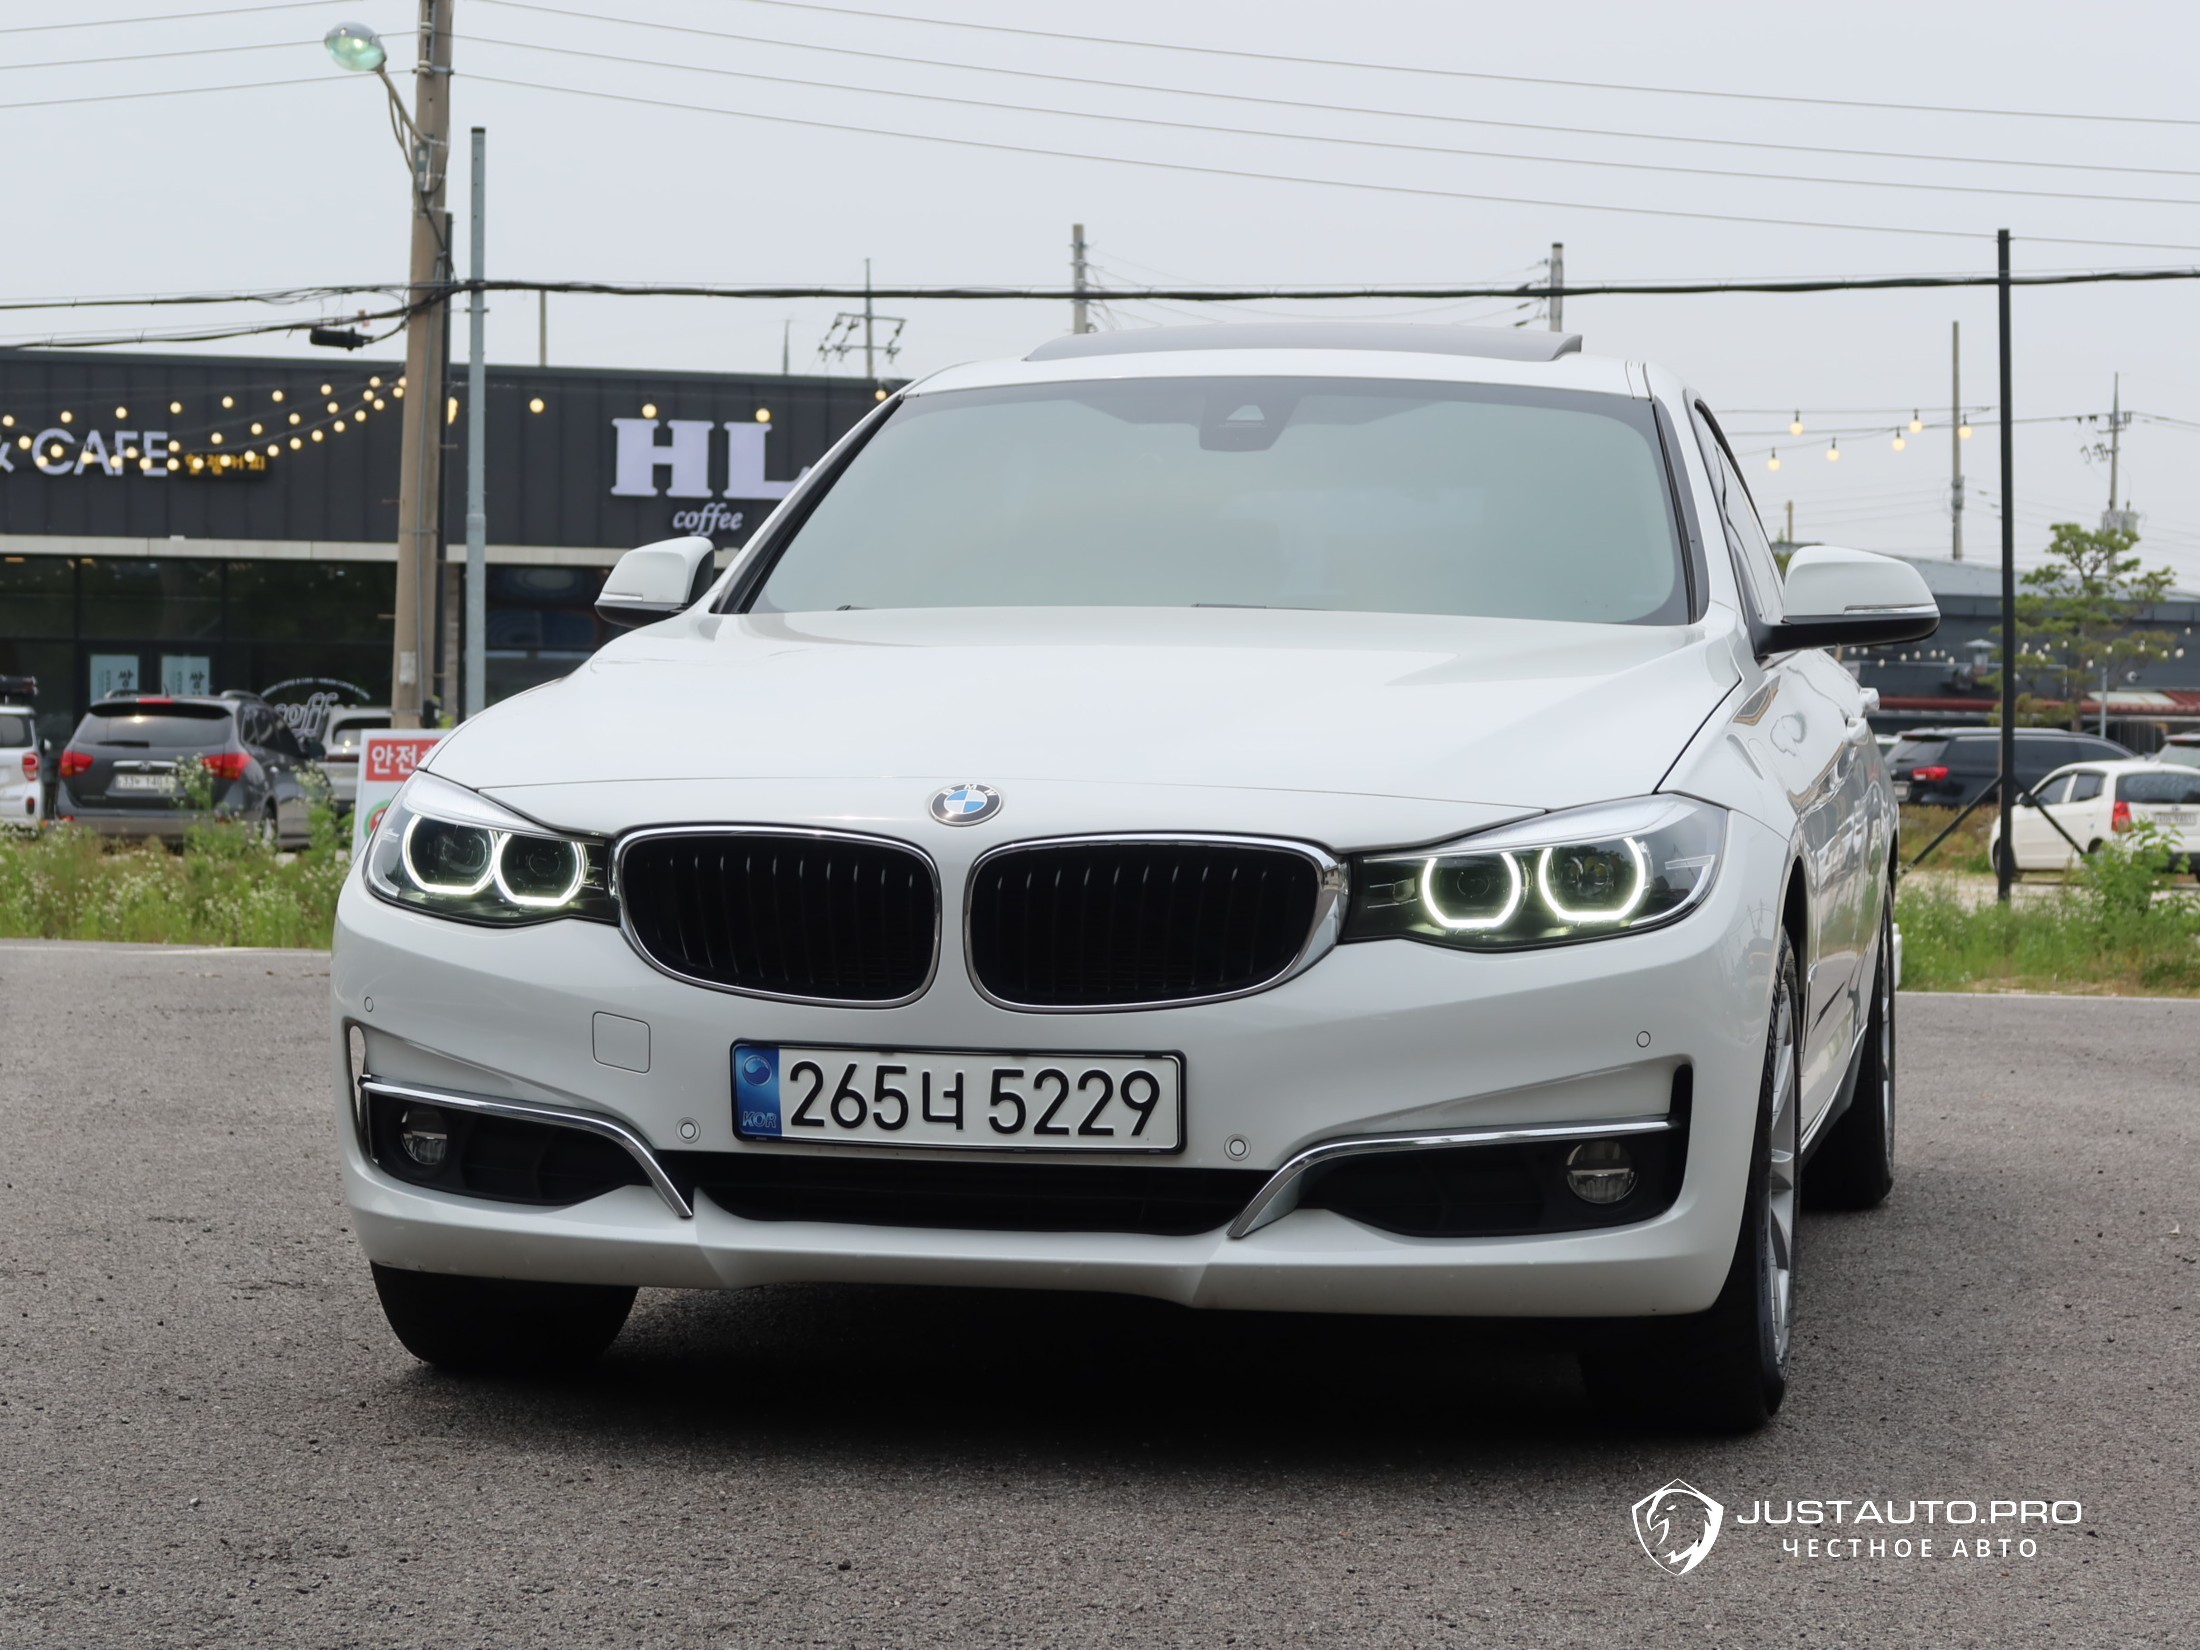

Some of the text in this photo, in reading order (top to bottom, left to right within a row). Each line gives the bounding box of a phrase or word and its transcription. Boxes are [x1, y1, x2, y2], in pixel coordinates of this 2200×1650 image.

[32, 428, 168, 476] CAFE
[611, 418, 812, 500] HL
[673, 502, 743, 538] coffee
[274, 692, 357, 737] coff
[371, 744, 434, 775] 안전
[742, 1110, 777, 1128] KOR
[789, 1061, 1161, 1137] 265너 5229
